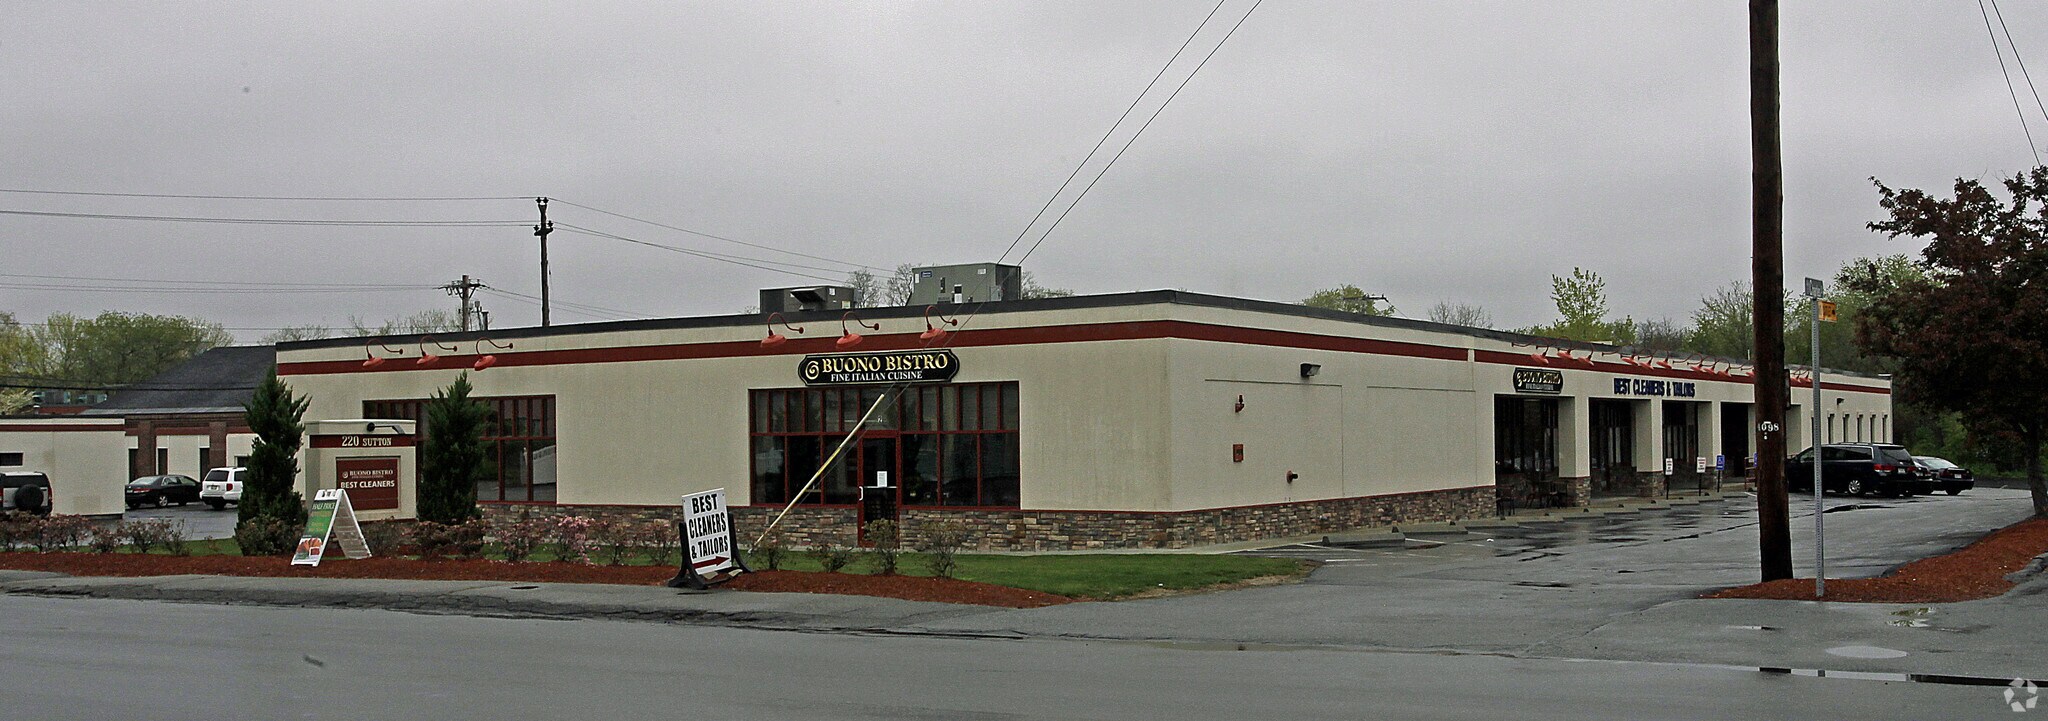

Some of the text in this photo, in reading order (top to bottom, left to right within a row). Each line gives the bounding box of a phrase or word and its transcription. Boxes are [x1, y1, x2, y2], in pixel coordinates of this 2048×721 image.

[822, 353, 948, 373] BUONO BISTRO
[830, 370, 923, 382] FINE ITALIAN CUISINE
[1613, 378, 1631, 395] BEST
[341, 435, 392, 447] 220 SUTTON
[340, 480, 395, 489] BEST CLEANERS
[691, 493, 718, 515] BEST
[688, 511, 727, 540] CLEANERS
[691, 534, 729, 560] & TAILORS
